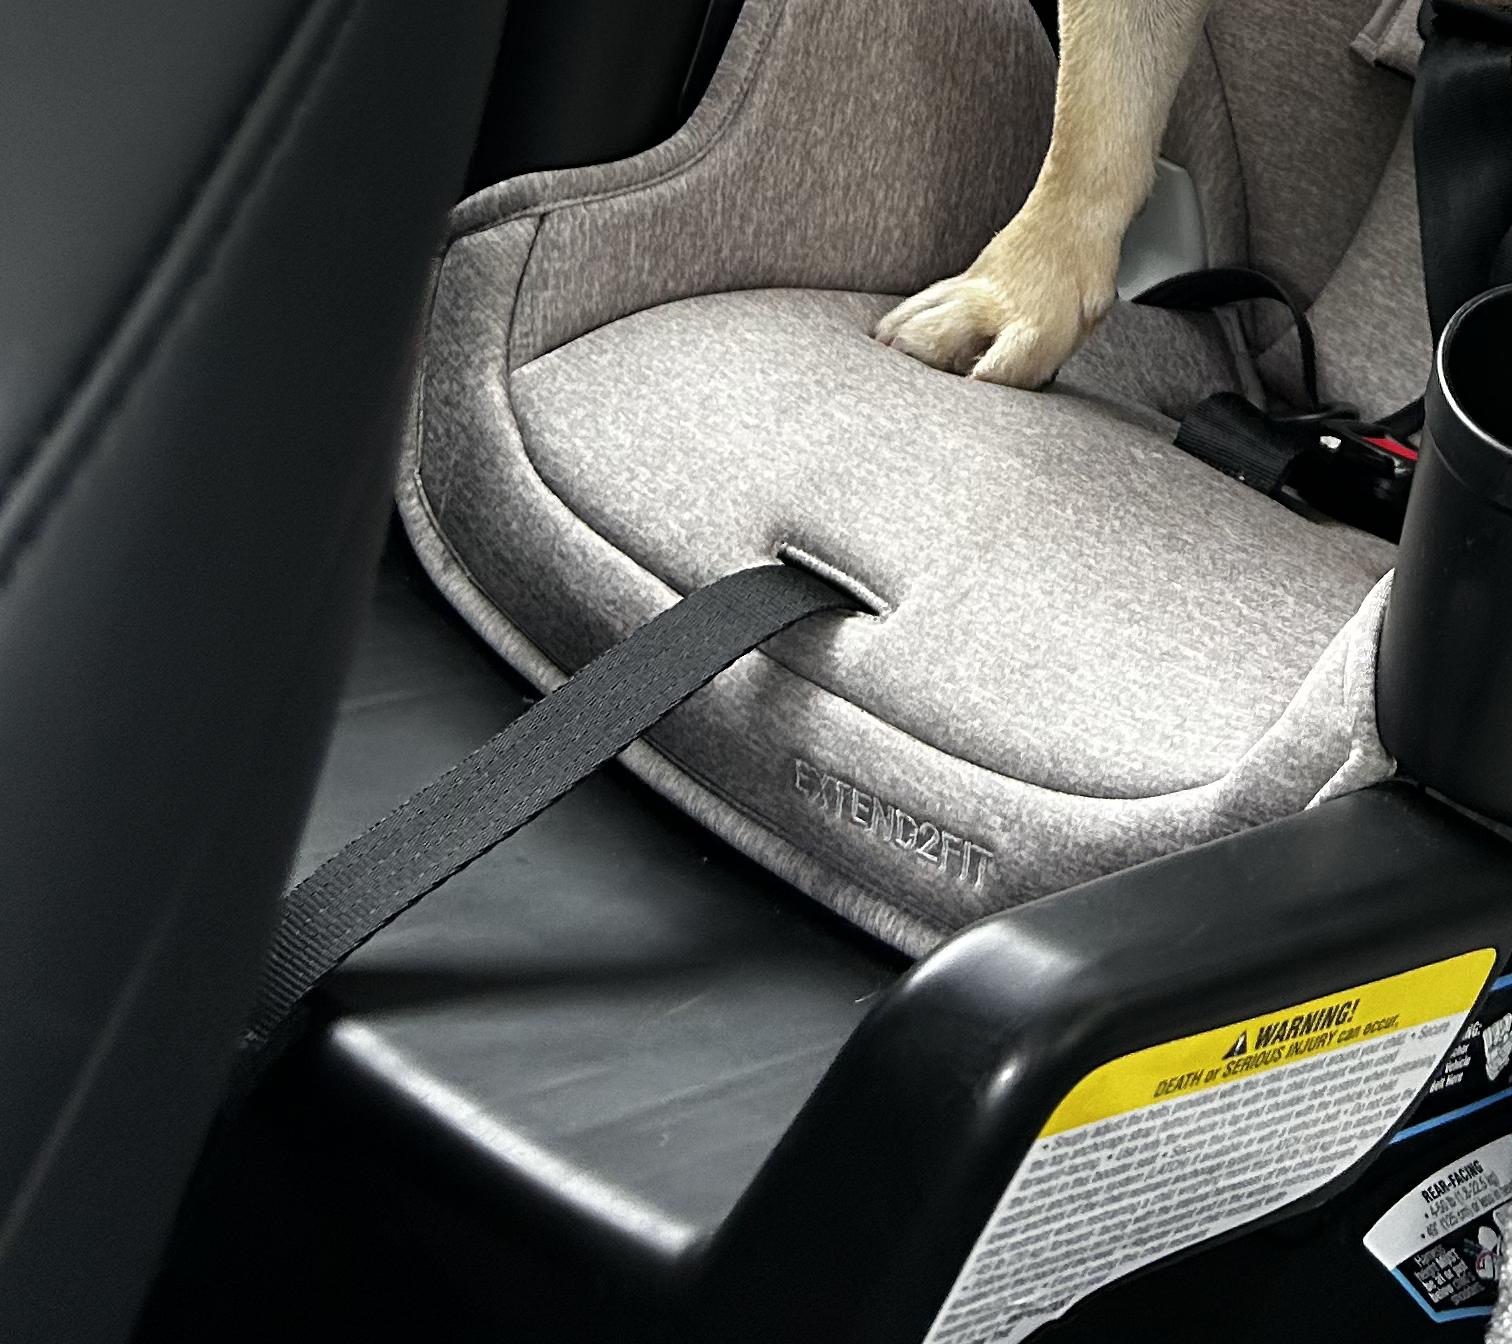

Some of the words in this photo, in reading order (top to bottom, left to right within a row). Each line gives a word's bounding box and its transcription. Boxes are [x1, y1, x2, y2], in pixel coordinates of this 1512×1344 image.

[1254, 998, 1361, 1050] WARNING!
[1153, 1070, 1203, 1098] DEATH
[1204, 1067, 1222, 1084] or
[1222, 1045, 1286, 1079] SERIOUS
[1285, 1029, 1337, 1059] INJURY
[1337, 1025, 1362, 1044] can
[1421, 1159, 1484, 1203] REAR-FACING
